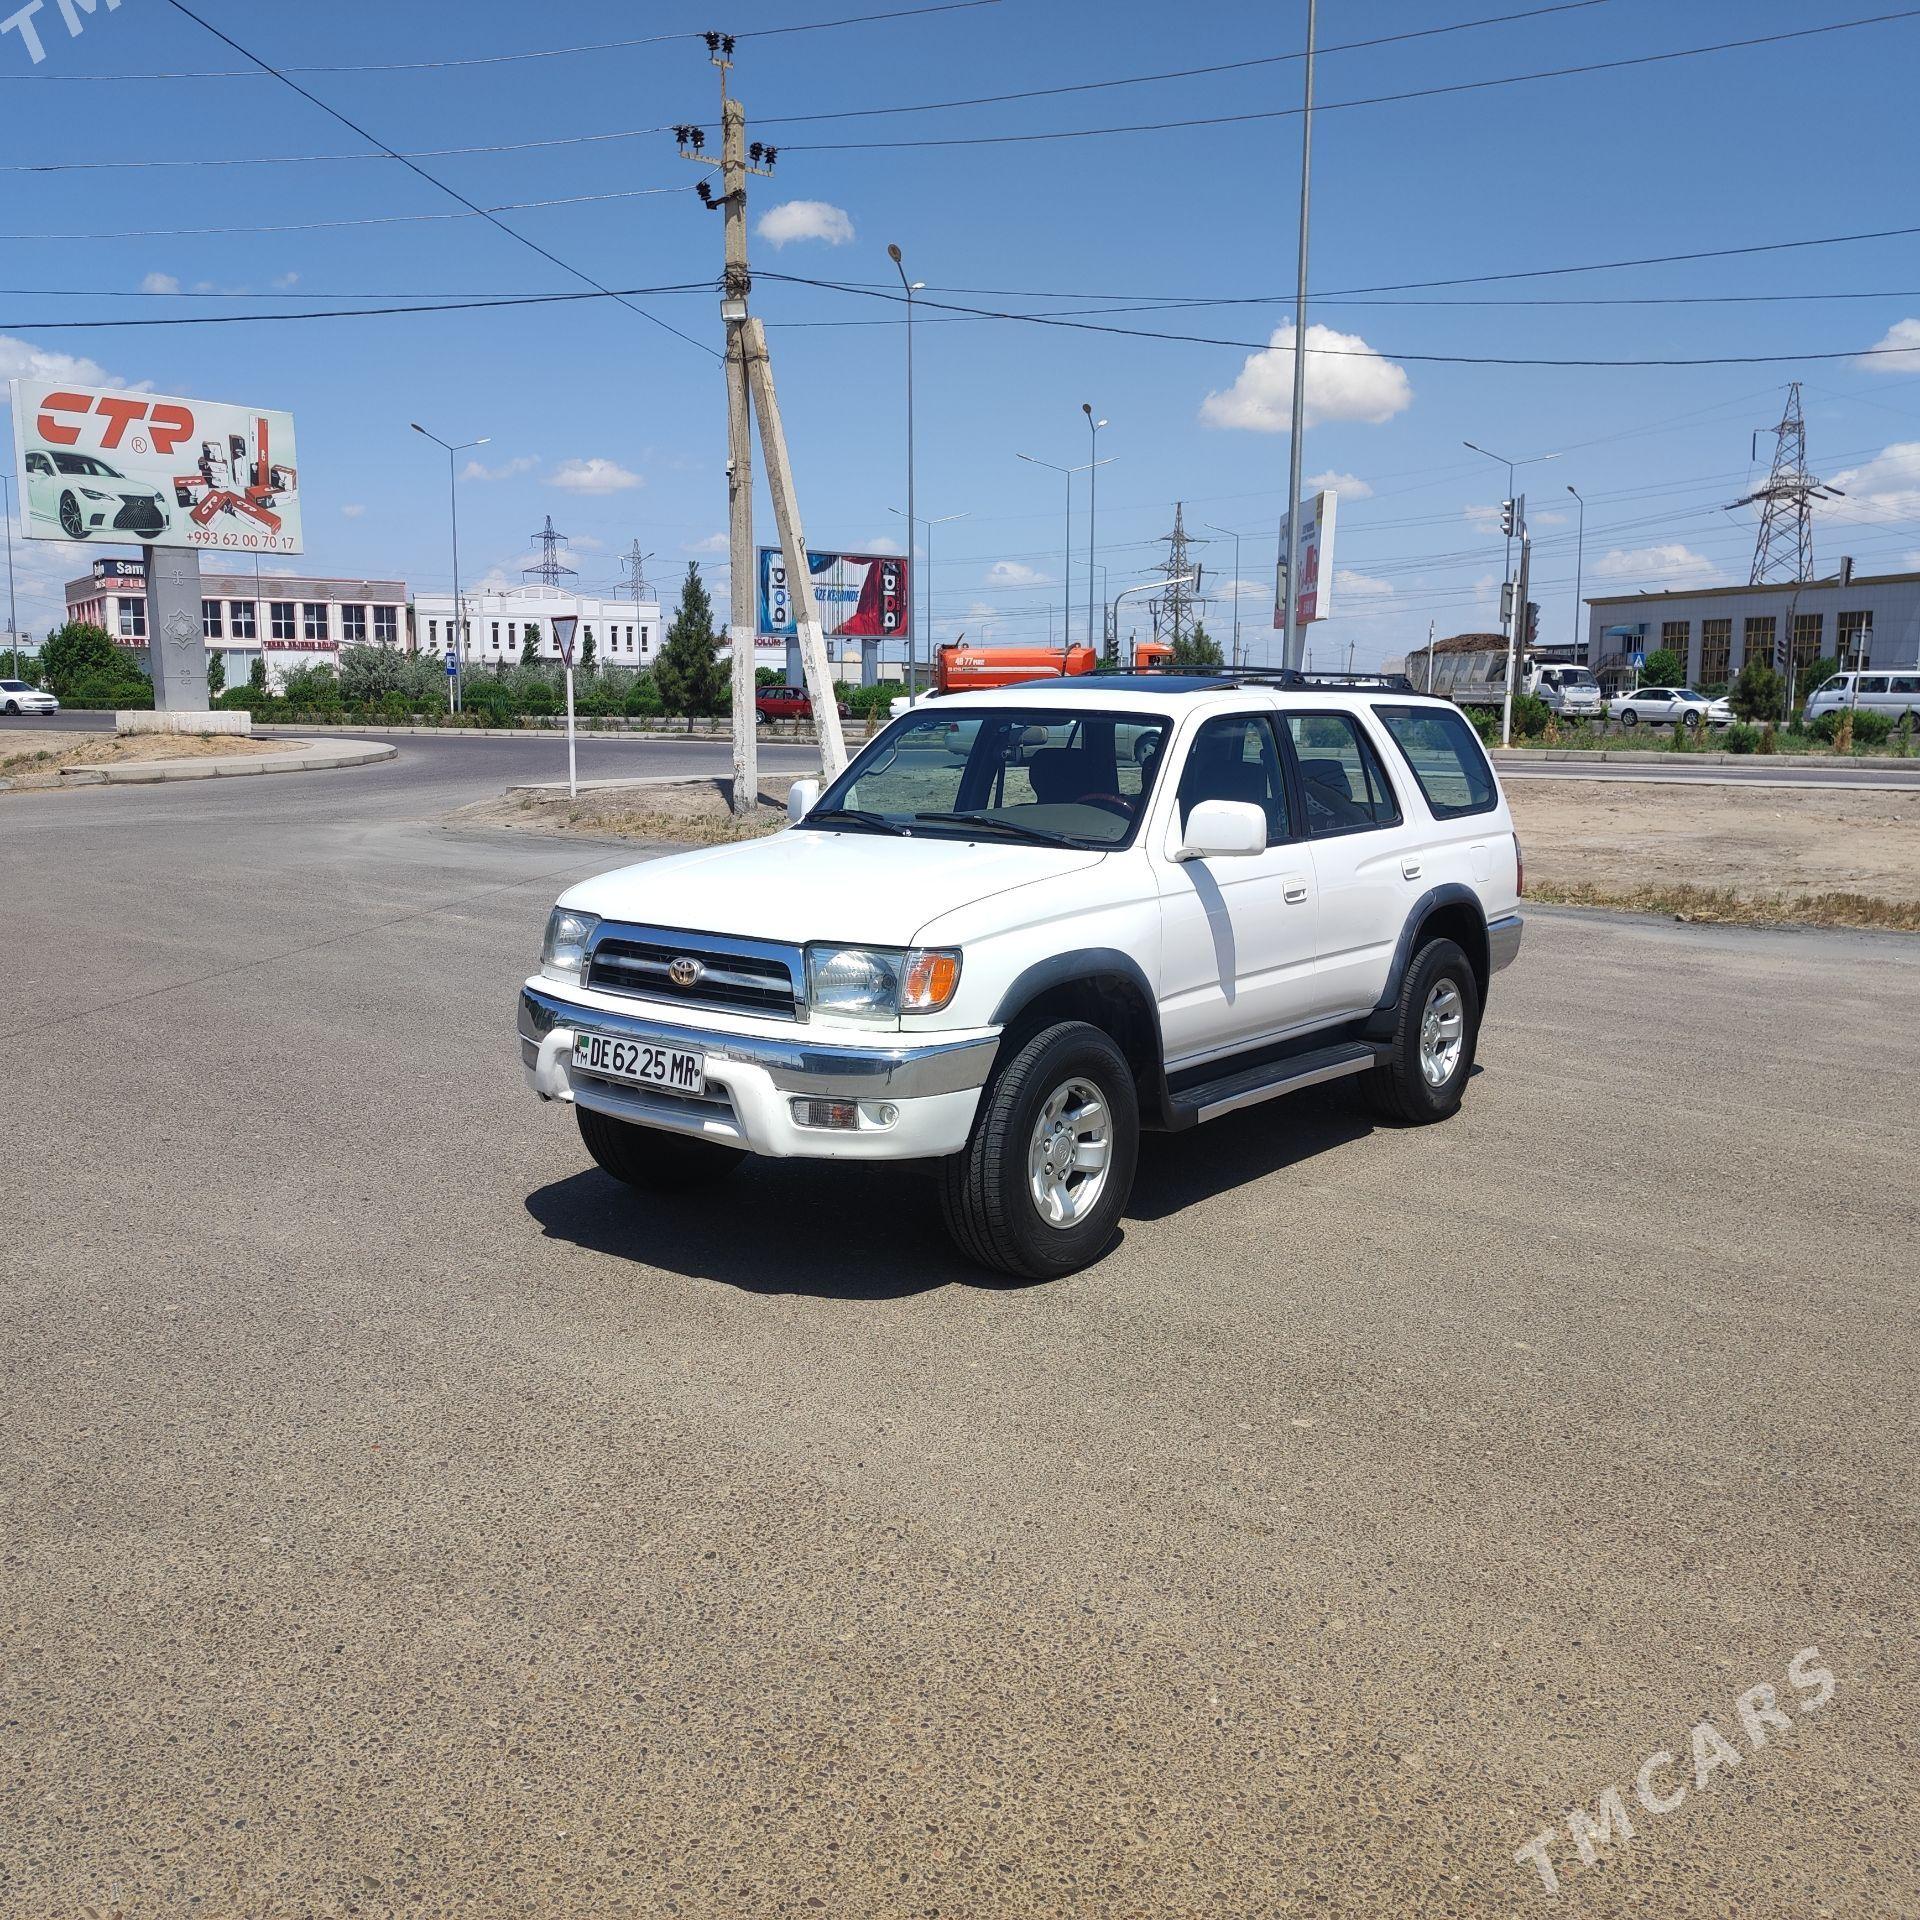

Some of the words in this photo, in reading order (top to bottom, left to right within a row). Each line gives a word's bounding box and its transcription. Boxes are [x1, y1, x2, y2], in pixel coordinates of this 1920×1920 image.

[187, 531, 218, 545] +993
[223, 533, 238, 546] 62
[242, 534, 258, 547] 00
[262, 535, 277, 549] 70
[282, 537, 294, 549] 17
[116, 561, 145, 577] Sam
[883, 574, 896, 627] bold
